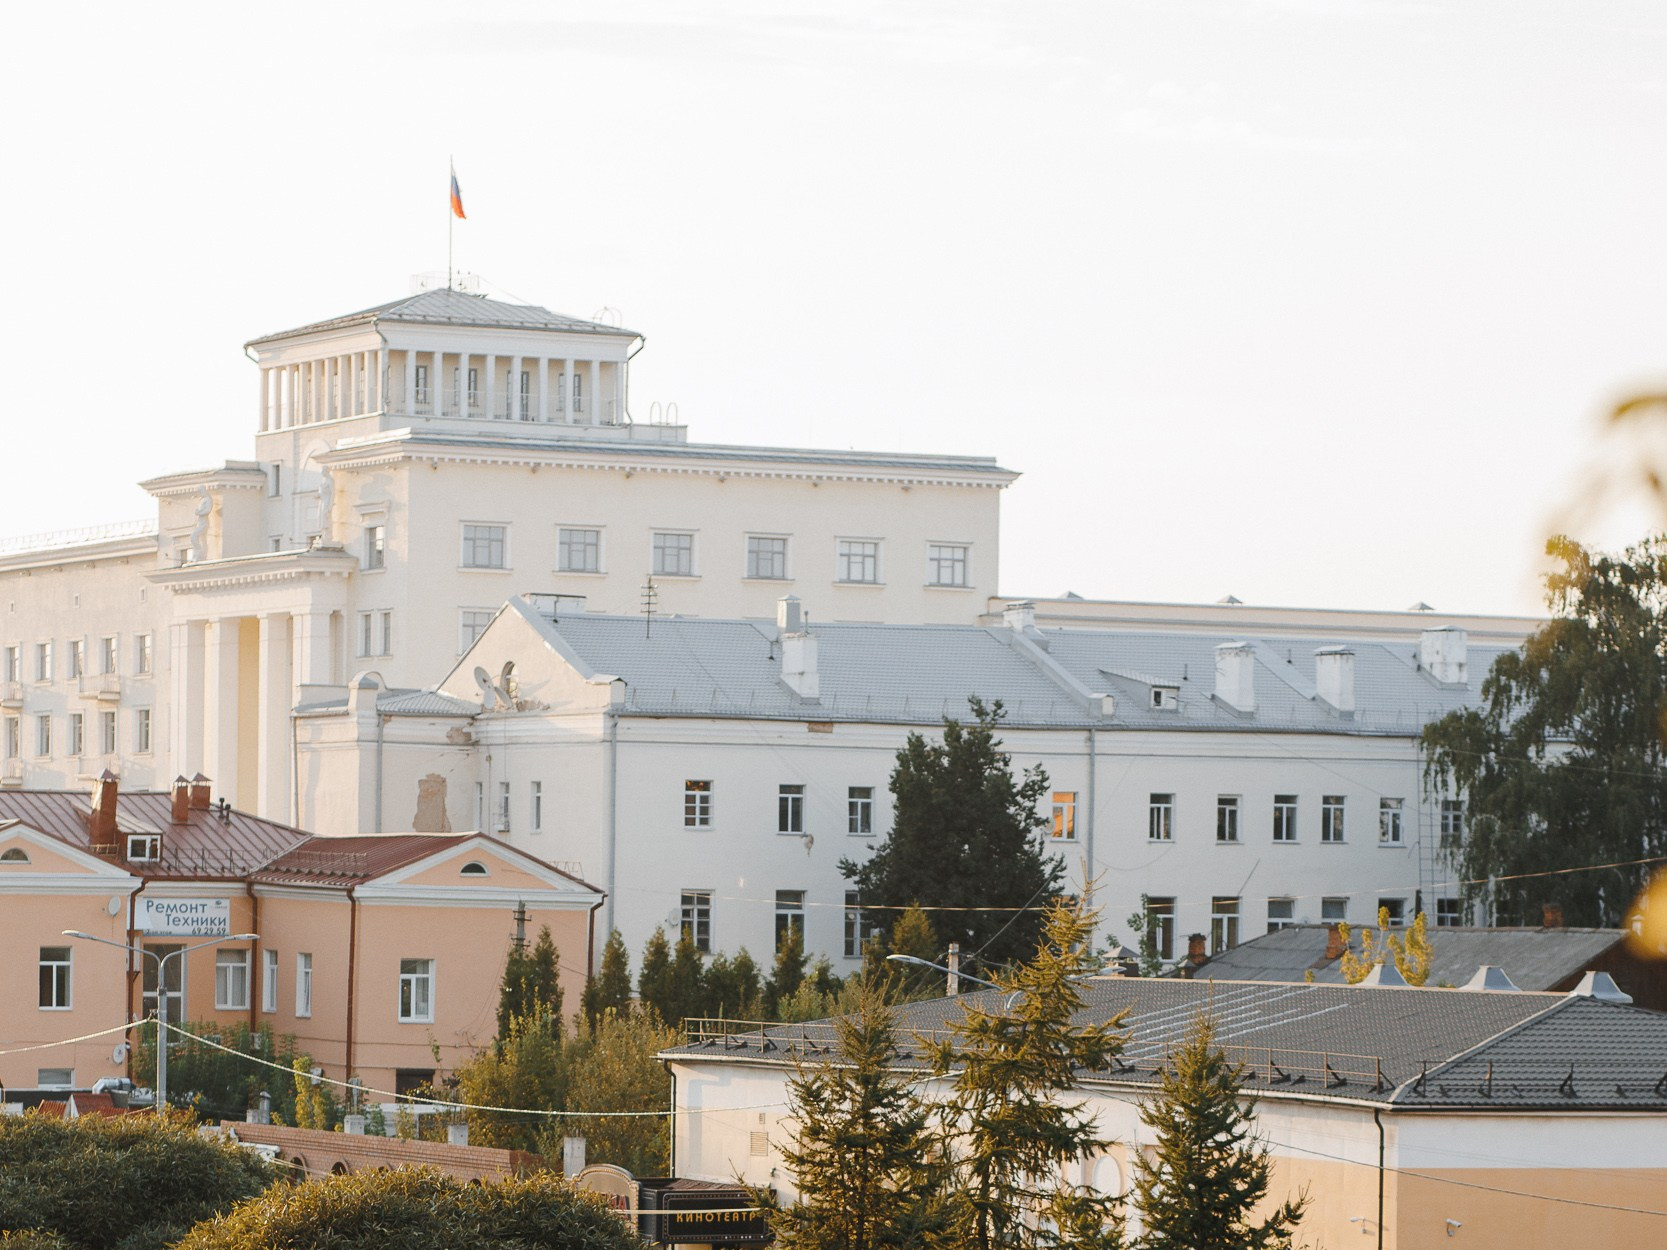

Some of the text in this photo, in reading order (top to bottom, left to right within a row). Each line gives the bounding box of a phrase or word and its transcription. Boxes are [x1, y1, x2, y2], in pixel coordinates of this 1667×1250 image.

[146, 900, 208, 914] Ремонт
[165, 914, 227, 927] Техники
[192, 927, 227, 935] 69 29 59
[676, 1211, 756, 1223] КИНОТЕАТР
